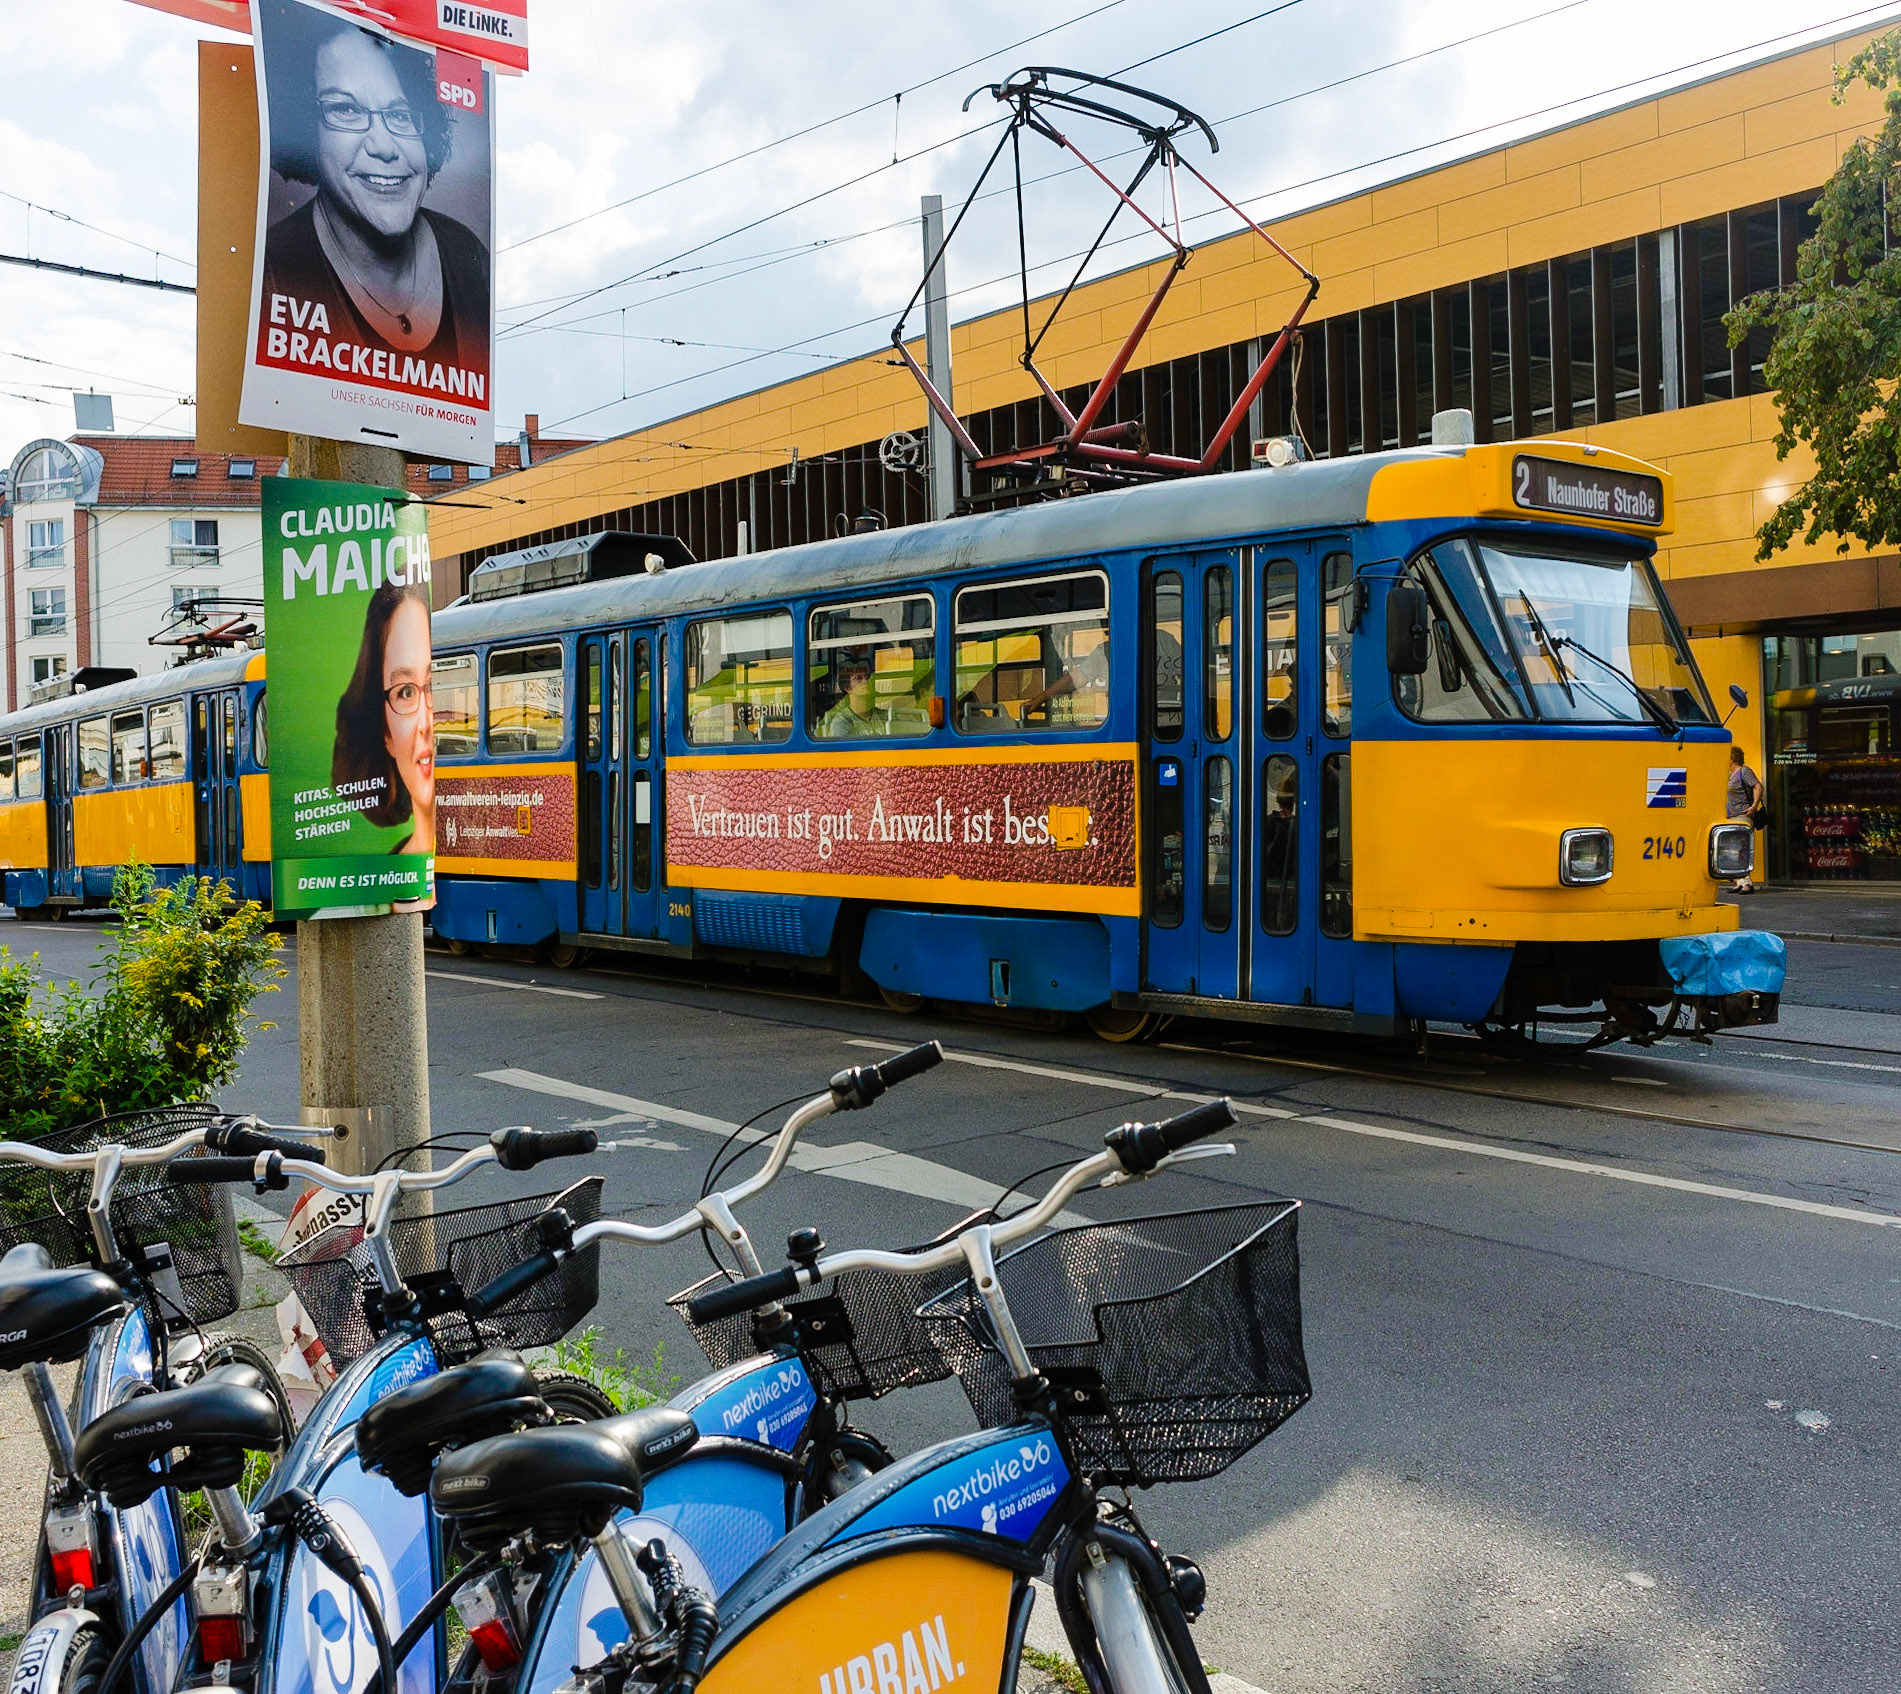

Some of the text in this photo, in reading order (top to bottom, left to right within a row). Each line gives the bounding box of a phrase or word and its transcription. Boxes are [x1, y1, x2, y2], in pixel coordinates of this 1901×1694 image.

[443, 5, 466, 27] DIE
[440, 81, 476, 108] SPD
[270, 293, 331, 335] EVA
[267, 327, 485, 400] BRACKELMANN
[331, 388, 477, 426] UNSER SACHSEN FÜR MORGEN
[1516, 461, 1655, 518] 2 Naunhofer Straße
[280, 502, 396, 539] CLAUDIA
[294, 776, 387, 805] KITAS, SCHULEN,
[294, 795, 379, 823] HOCHSCHULEN
[295, 819, 351, 841] STÄRKEN
[688, 794, 780, 839] Vertrauen
[787, 806, 812, 840] ist
[818, 808, 860, 860] gut.
[867, 793, 953, 844] Anwalt
[963, 806, 994, 843] ist
[1643, 836, 1686, 860] 2140
[298, 870, 419, 890] DENN ES IST MÖGLICH.
[669, 904, 691, 916] 2140
[722, 1381, 781, 1430] nextbike
[933, 1458, 1021, 1518] nextbike
[1000, 1482, 1057, 1521] 030 69205046
